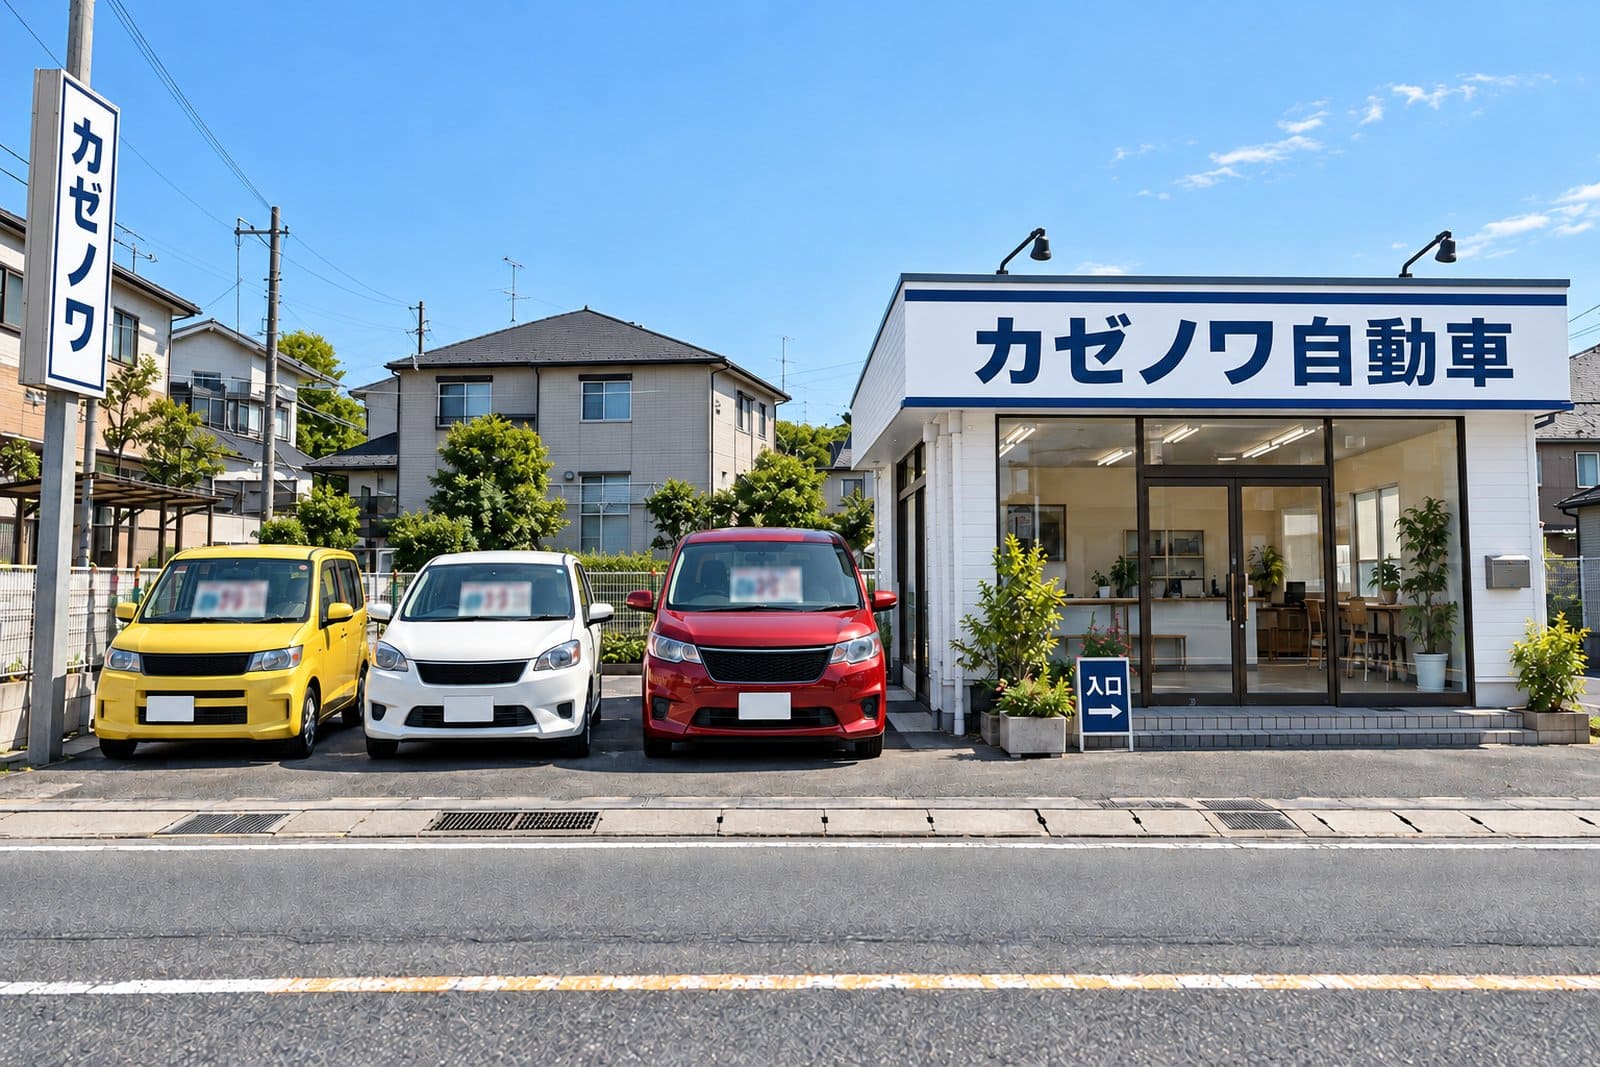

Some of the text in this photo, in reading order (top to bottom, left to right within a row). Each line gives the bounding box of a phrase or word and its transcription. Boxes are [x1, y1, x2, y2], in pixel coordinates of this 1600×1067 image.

[65, 117, 103, 353] カゼノワ
[974, 312, 1514, 388] カゼノワ自動車
[1086, 675, 1122, 696] 入口
